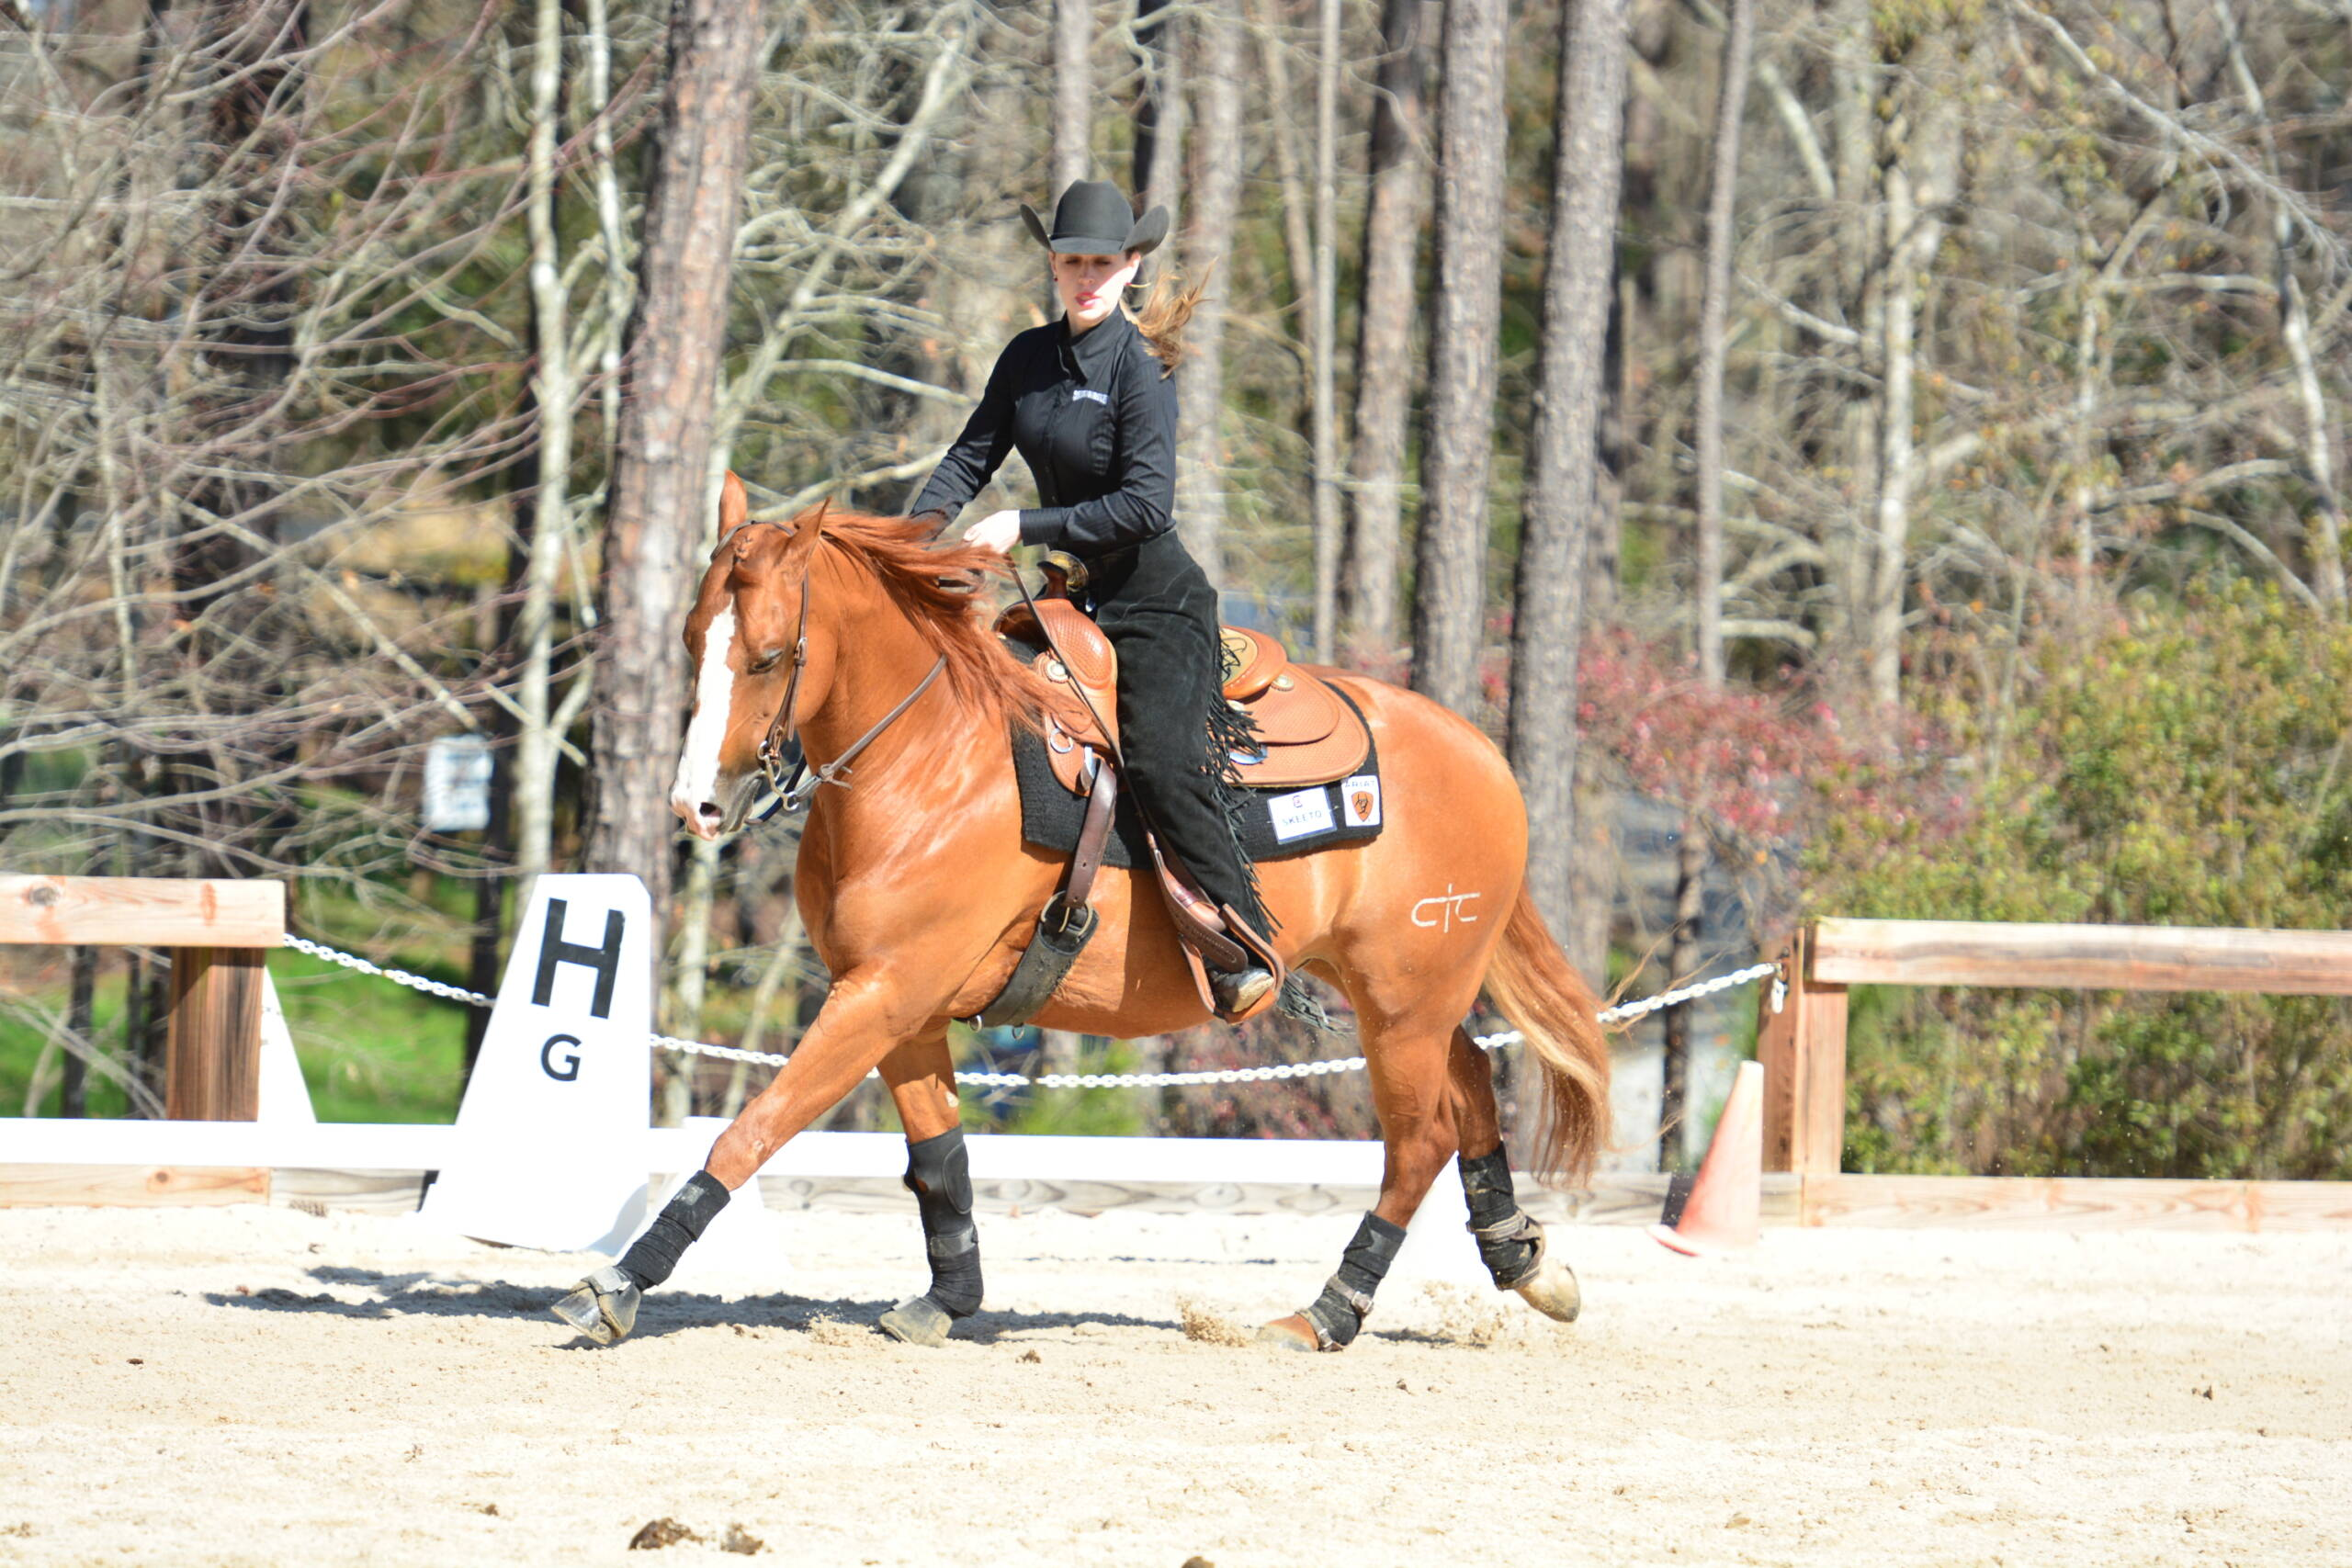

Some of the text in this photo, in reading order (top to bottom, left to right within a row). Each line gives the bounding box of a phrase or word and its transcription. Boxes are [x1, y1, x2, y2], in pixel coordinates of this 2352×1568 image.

[1282, 810, 1322, 826] SKEETO
[531, 897, 626, 1020] H
[540, 1033, 582, 1082] G
